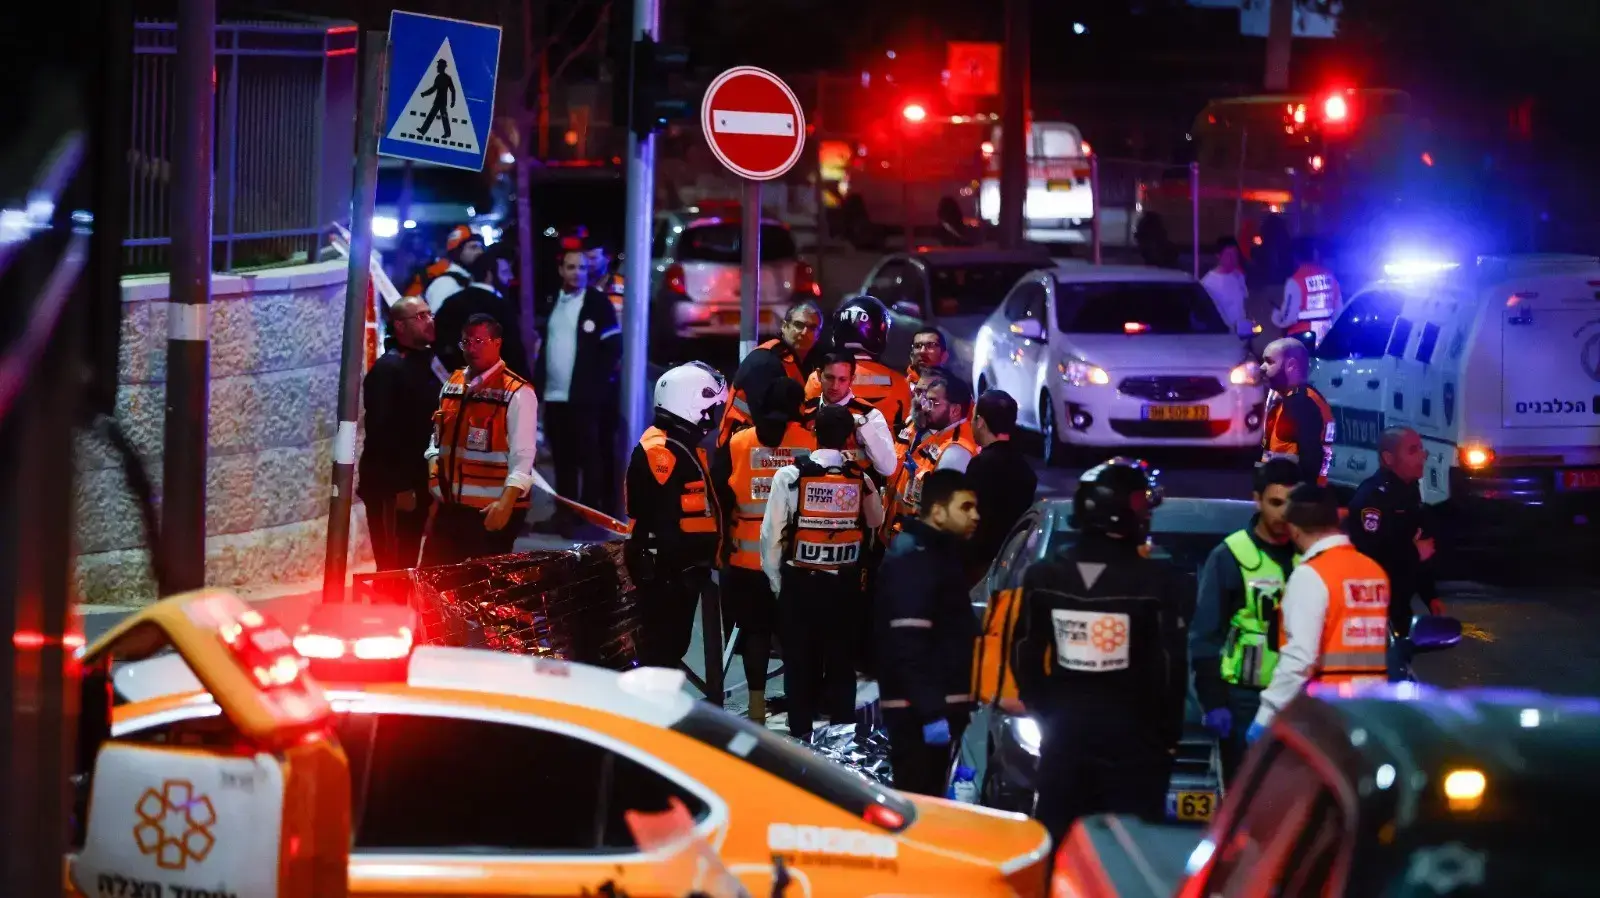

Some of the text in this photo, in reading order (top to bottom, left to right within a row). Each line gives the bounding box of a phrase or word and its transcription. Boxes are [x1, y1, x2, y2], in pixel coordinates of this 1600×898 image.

[1515, 398, 1586, 414] הכלבנים
[754, 484, 771, 493] צלה
[808, 487, 833, 495] איחוד
[808, 495, 832, 503] הצלה
[801, 544, 857, 562] חובש
[1183, 794, 1210, 815] 63
